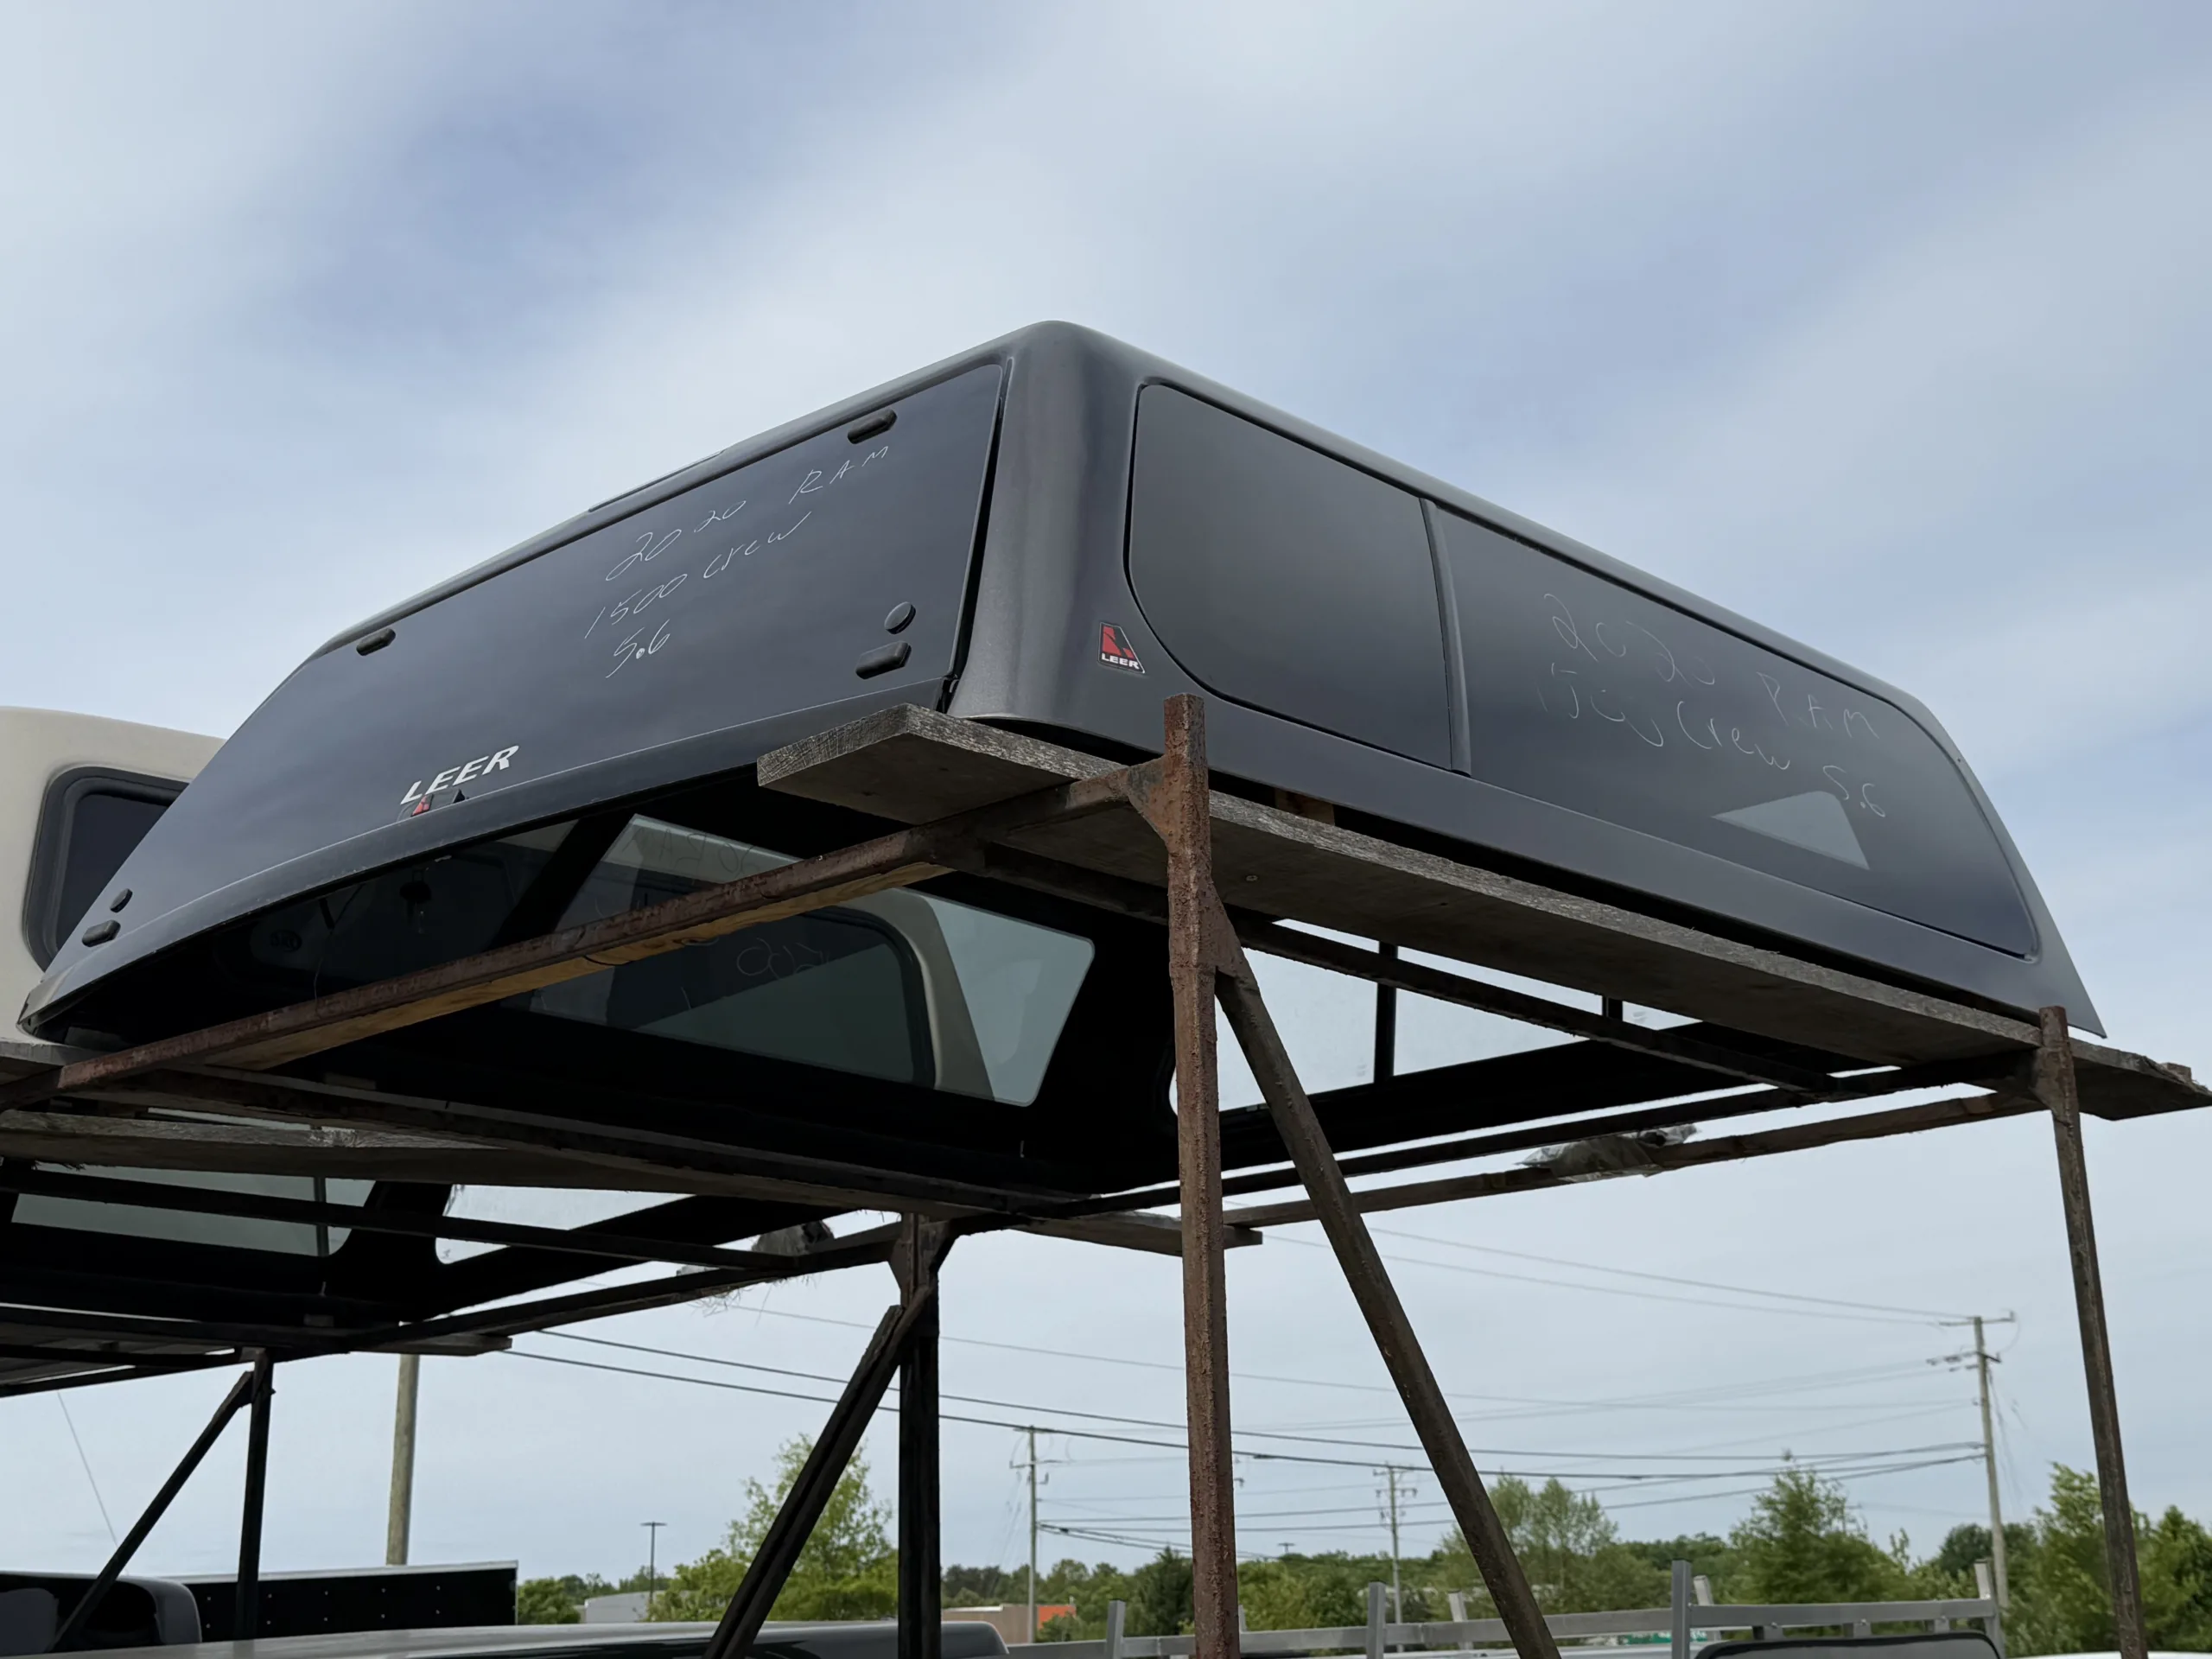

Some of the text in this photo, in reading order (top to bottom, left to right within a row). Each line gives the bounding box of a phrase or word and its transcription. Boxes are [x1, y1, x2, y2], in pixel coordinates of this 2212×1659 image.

[788, 445, 889, 505] RAM
[584, 573, 688, 639] 1500
[605, 619, 671, 678] 5.6
[1101, 652, 1140, 670] LEER
[399, 745, 520, 805] LEER
